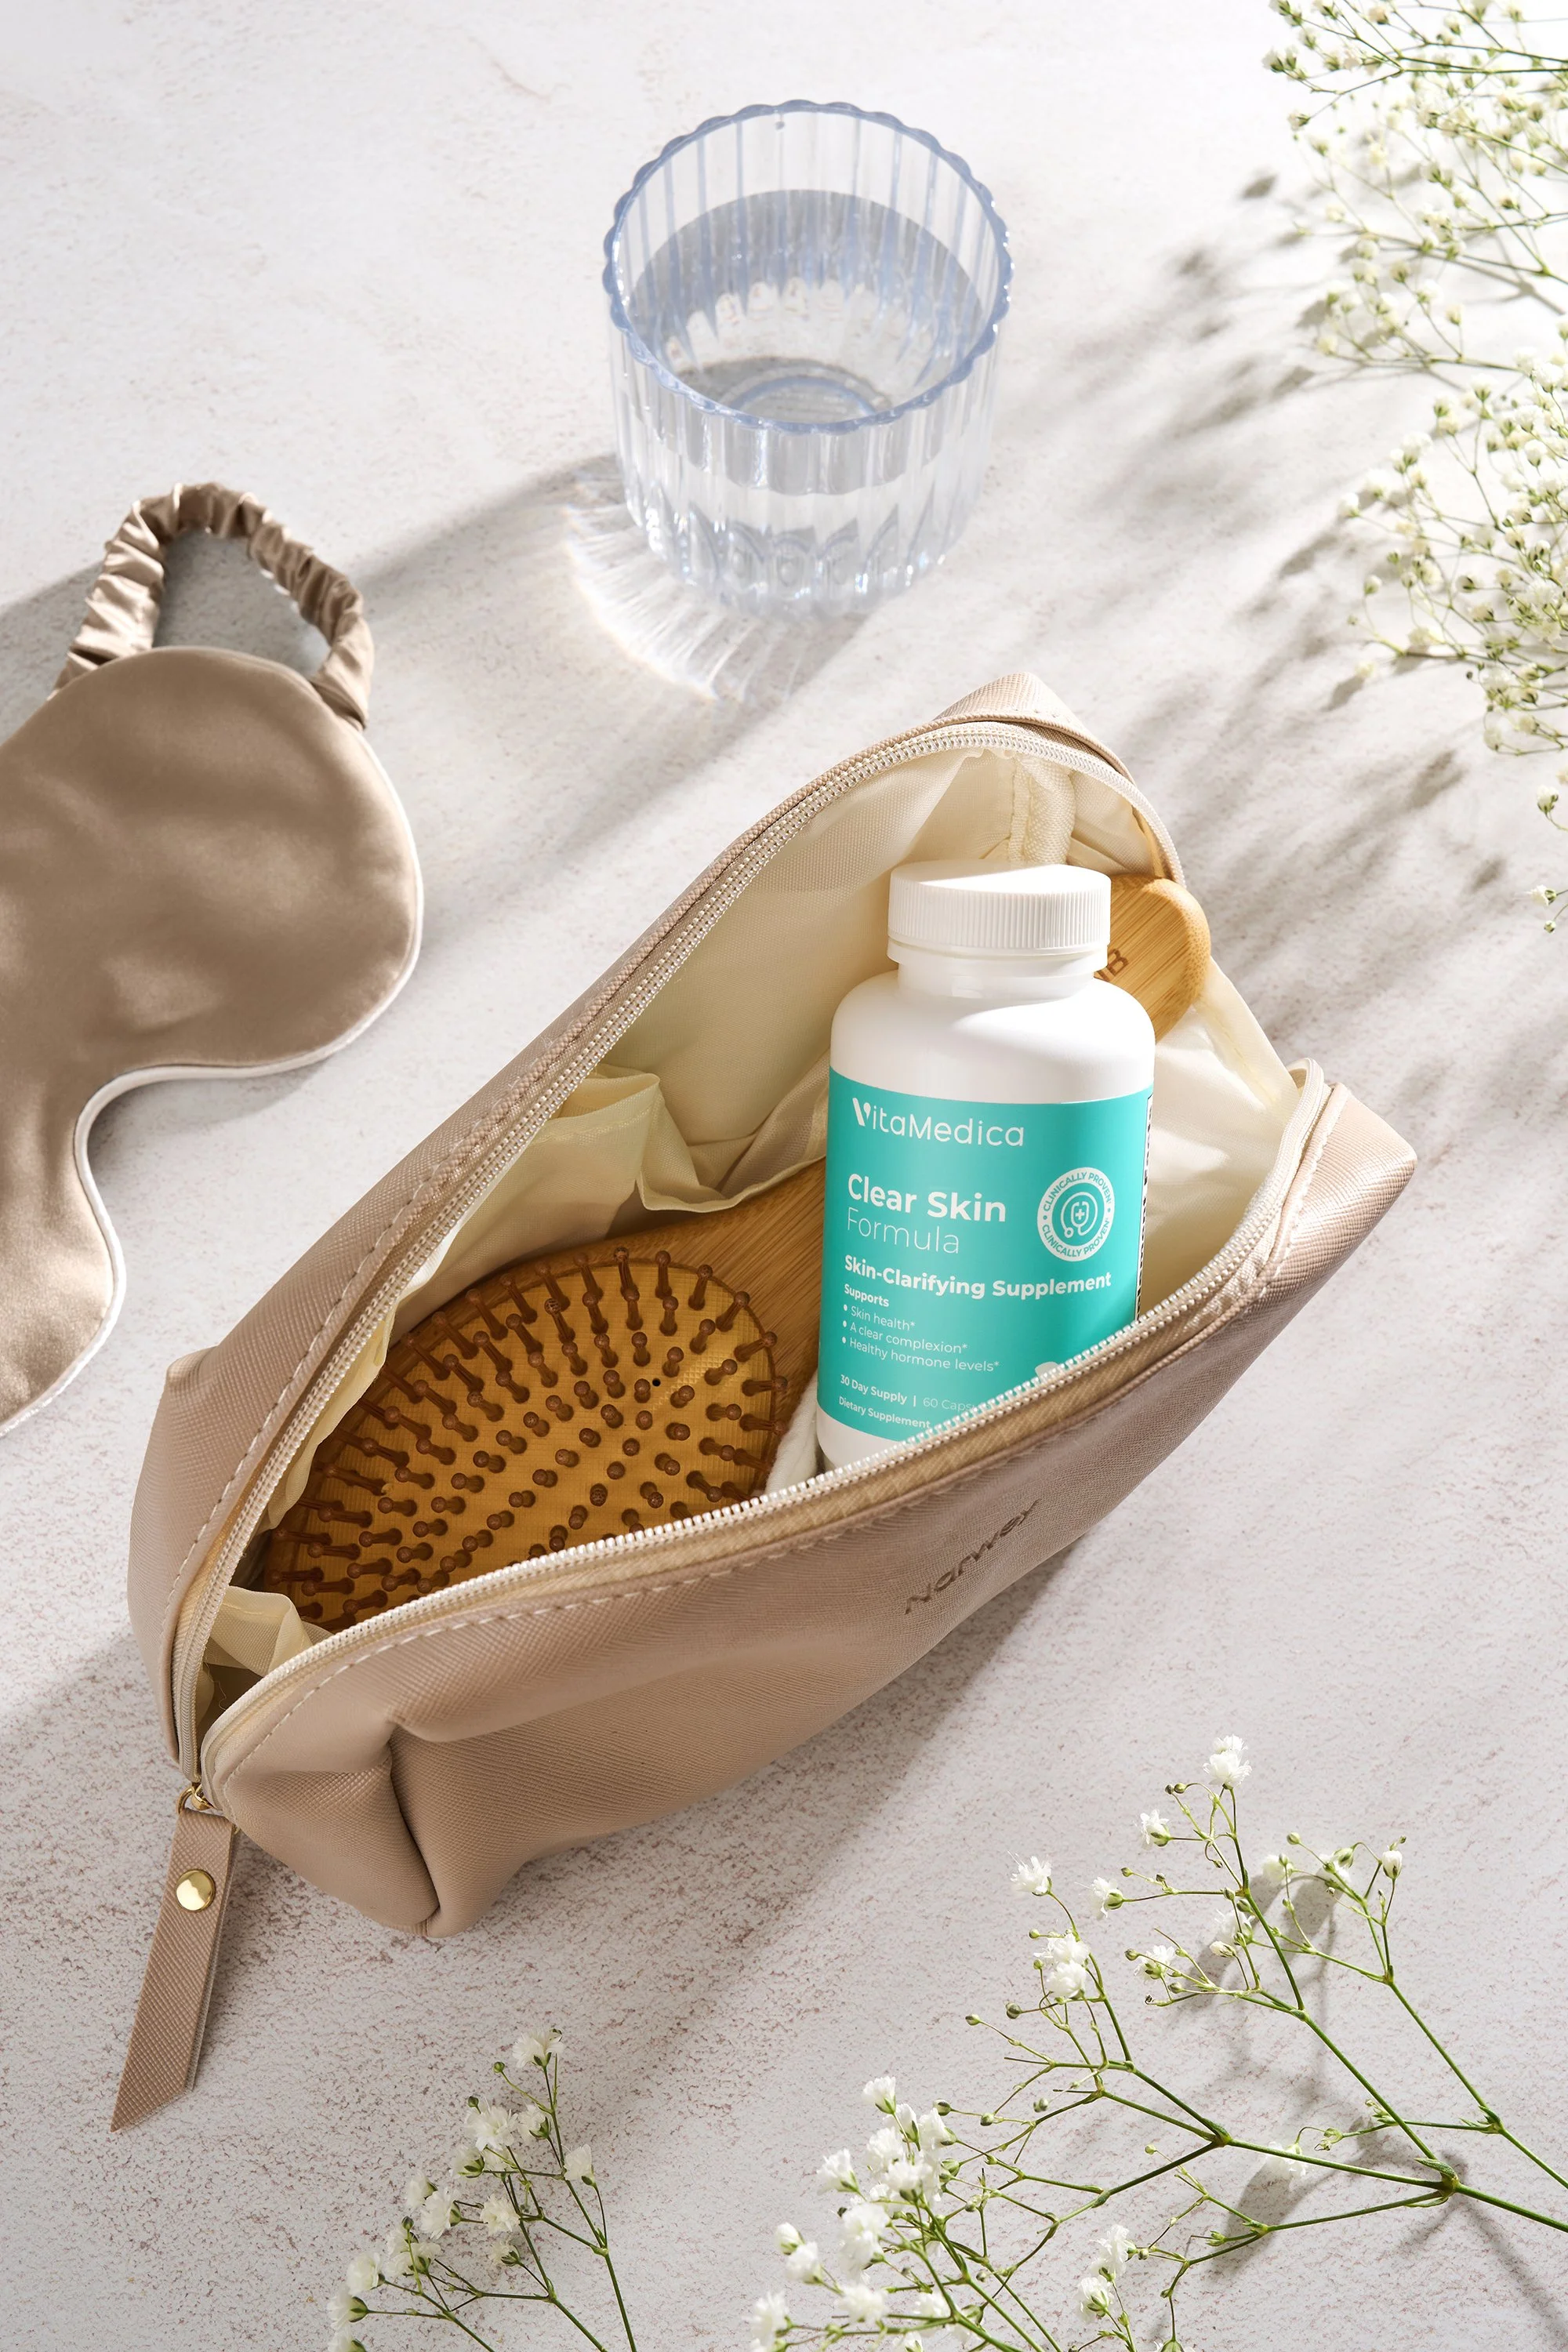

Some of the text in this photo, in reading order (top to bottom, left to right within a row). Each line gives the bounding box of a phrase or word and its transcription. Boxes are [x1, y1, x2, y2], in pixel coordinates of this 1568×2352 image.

[852, 1098, 1024, 1146] VitaMedica
[848, 1174, 1006, 1222] Clear Skin
[1044, 1172, 1087, 1211] CLINICALLY
[847, 1207, 960, 1254] Formula
[1042, 1224, 1082, 1257] CLINICALLY
[844, 1254, 1112, 1301] Skin-Clarifying Supplement
[844, 1283, 890, 1308] Supports
[851, 1305, 871, 1322] Skin
[850, 1322, 857, 1333] A
[858, 1326, 883, 1341] clear
[849, 1338, 888, 1360] Healthy
[891, 1349, 951, 1369] hormone
[840, 1374, 850, 1386] 30
[851, 1379, 869, 1395] Day
[870, 1386, 908, 1406] Supply
[923, 1397, 938, 1409] 60
[839, 1396, 931, 1429] Dietary Supplement
